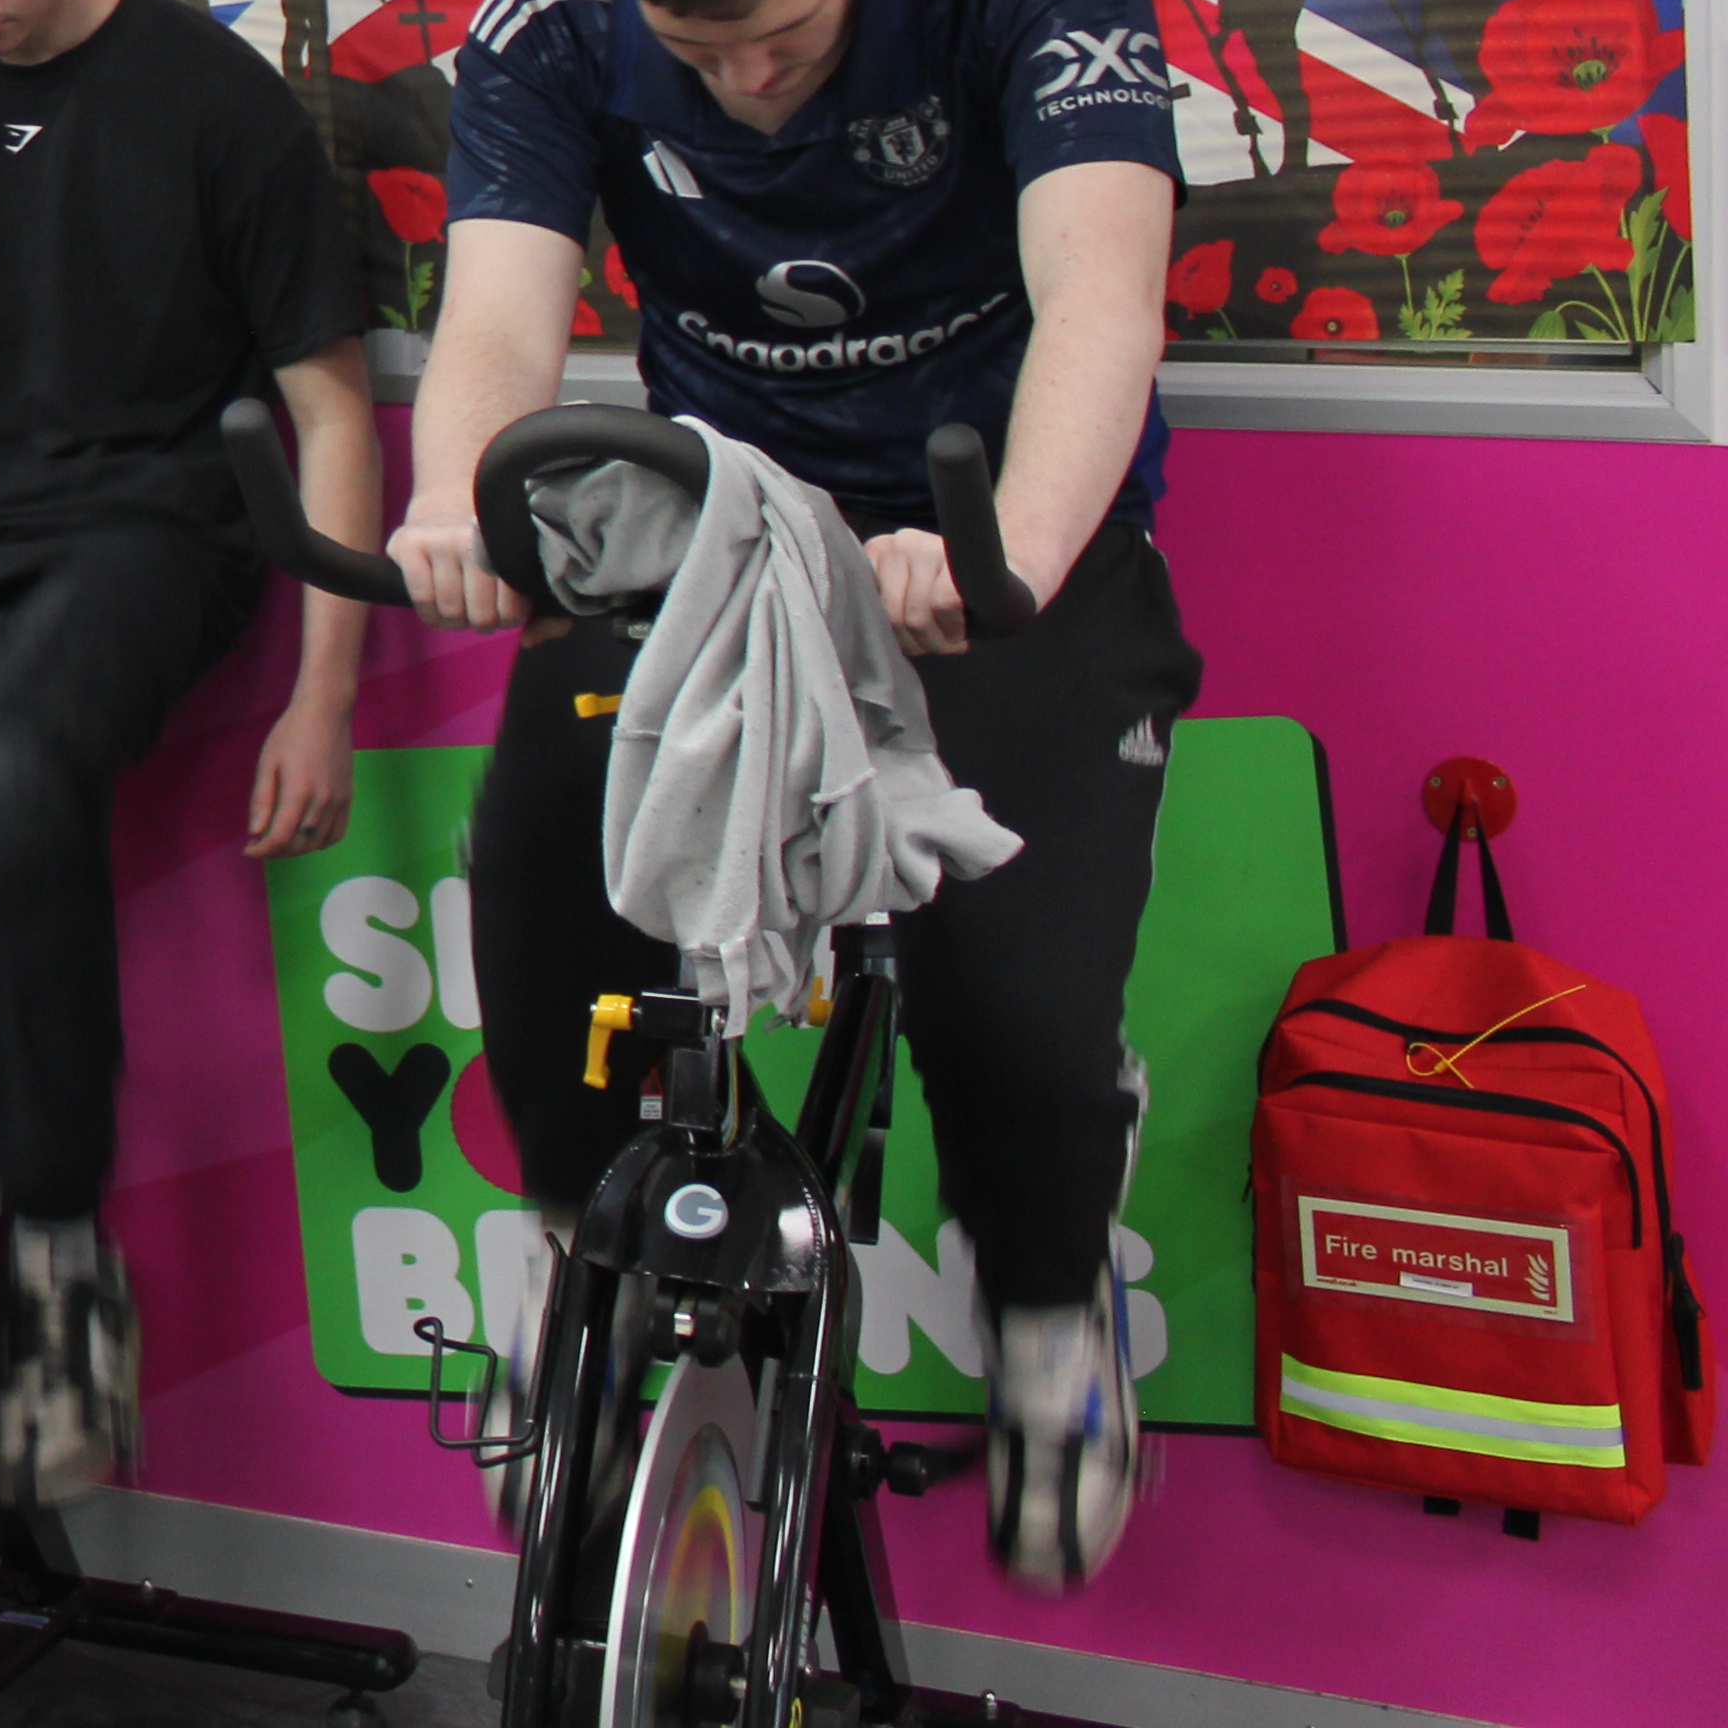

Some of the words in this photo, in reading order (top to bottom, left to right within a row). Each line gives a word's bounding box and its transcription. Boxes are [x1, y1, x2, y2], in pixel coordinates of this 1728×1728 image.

[1035, 88, 1172, 122] TECHNOLOG
[1325, 1233, 1378, 1261] Fire
[1392, 1246, 1509, 1278] marshal
